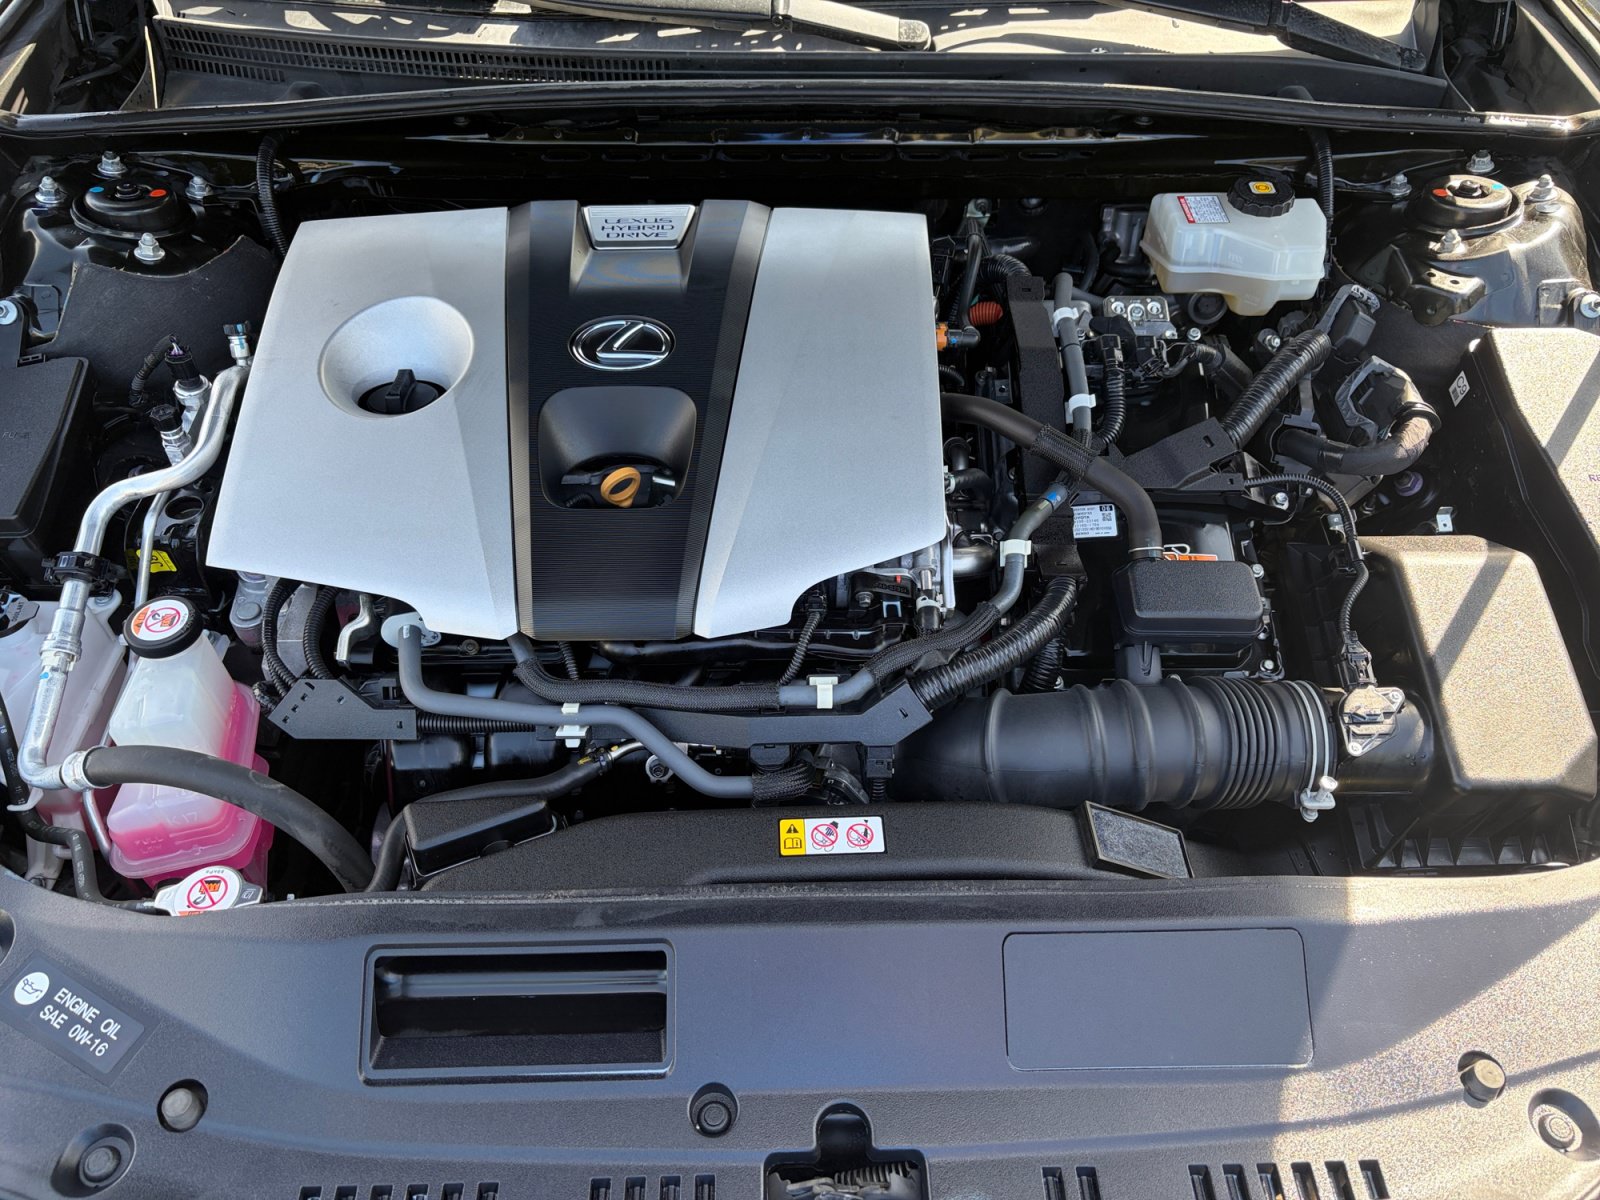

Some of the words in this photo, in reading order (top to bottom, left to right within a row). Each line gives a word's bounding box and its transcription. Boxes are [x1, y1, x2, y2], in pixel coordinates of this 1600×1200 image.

[601, 224, 675, 232] HYBRID
[606, 231, 669, 239] DRIVE
[1456, 375, 1468, 395] C9
[54, 987, 100, 1023] ENGINE
[100, 1018, 121, 1041] OIL
[40, 1005, 69, 1029] SAE
[68, 1024, 109, 1057] 0W-16
